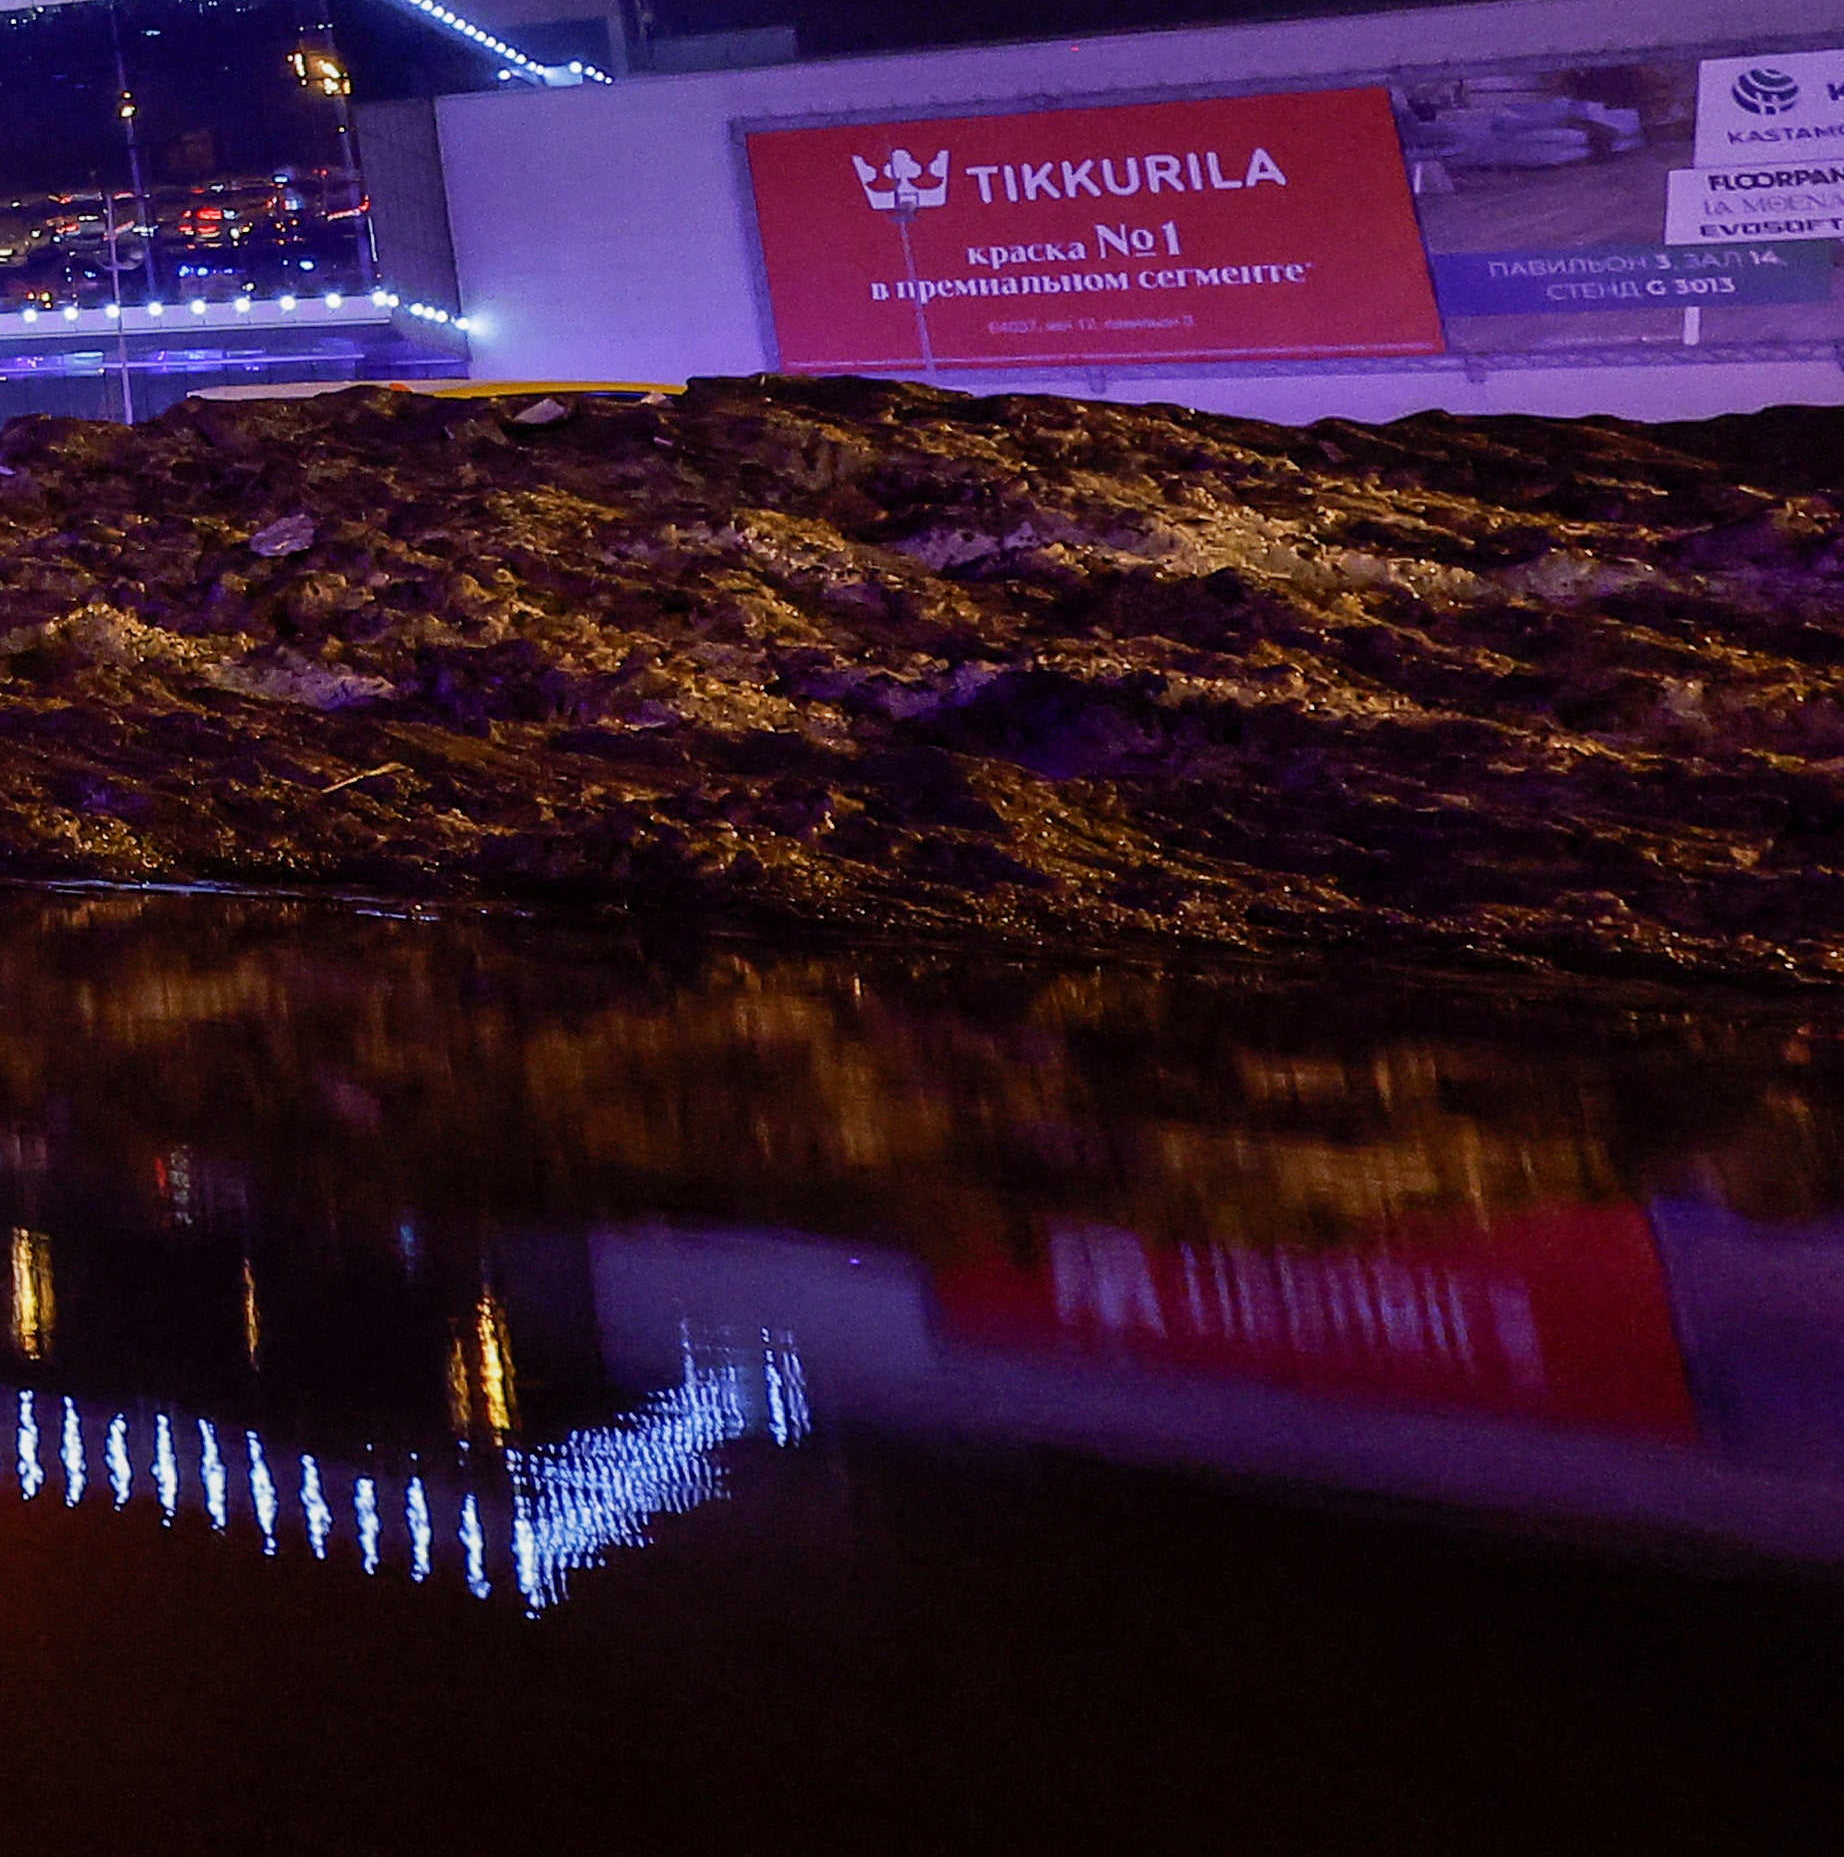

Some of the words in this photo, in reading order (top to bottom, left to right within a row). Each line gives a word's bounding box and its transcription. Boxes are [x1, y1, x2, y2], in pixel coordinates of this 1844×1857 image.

[965, 147, 1288, 204] TIKKURILA
[1700, 217, 1843, 238] EVOSOFT
[966, 240, 1088, 270] краска
[1486, 256, 1647, 278] ПАВИЛЬОН
[1683, 249, 1744, 270] ЗАЛ
[870, 282, 891, 301] в
[896, 268, 1130, 305] премиальном
[1546, 280, 1643, 301] СТЕНД
[1645, 279, 1667, 295] G
[1674, 276, 1737, 295] 3013
